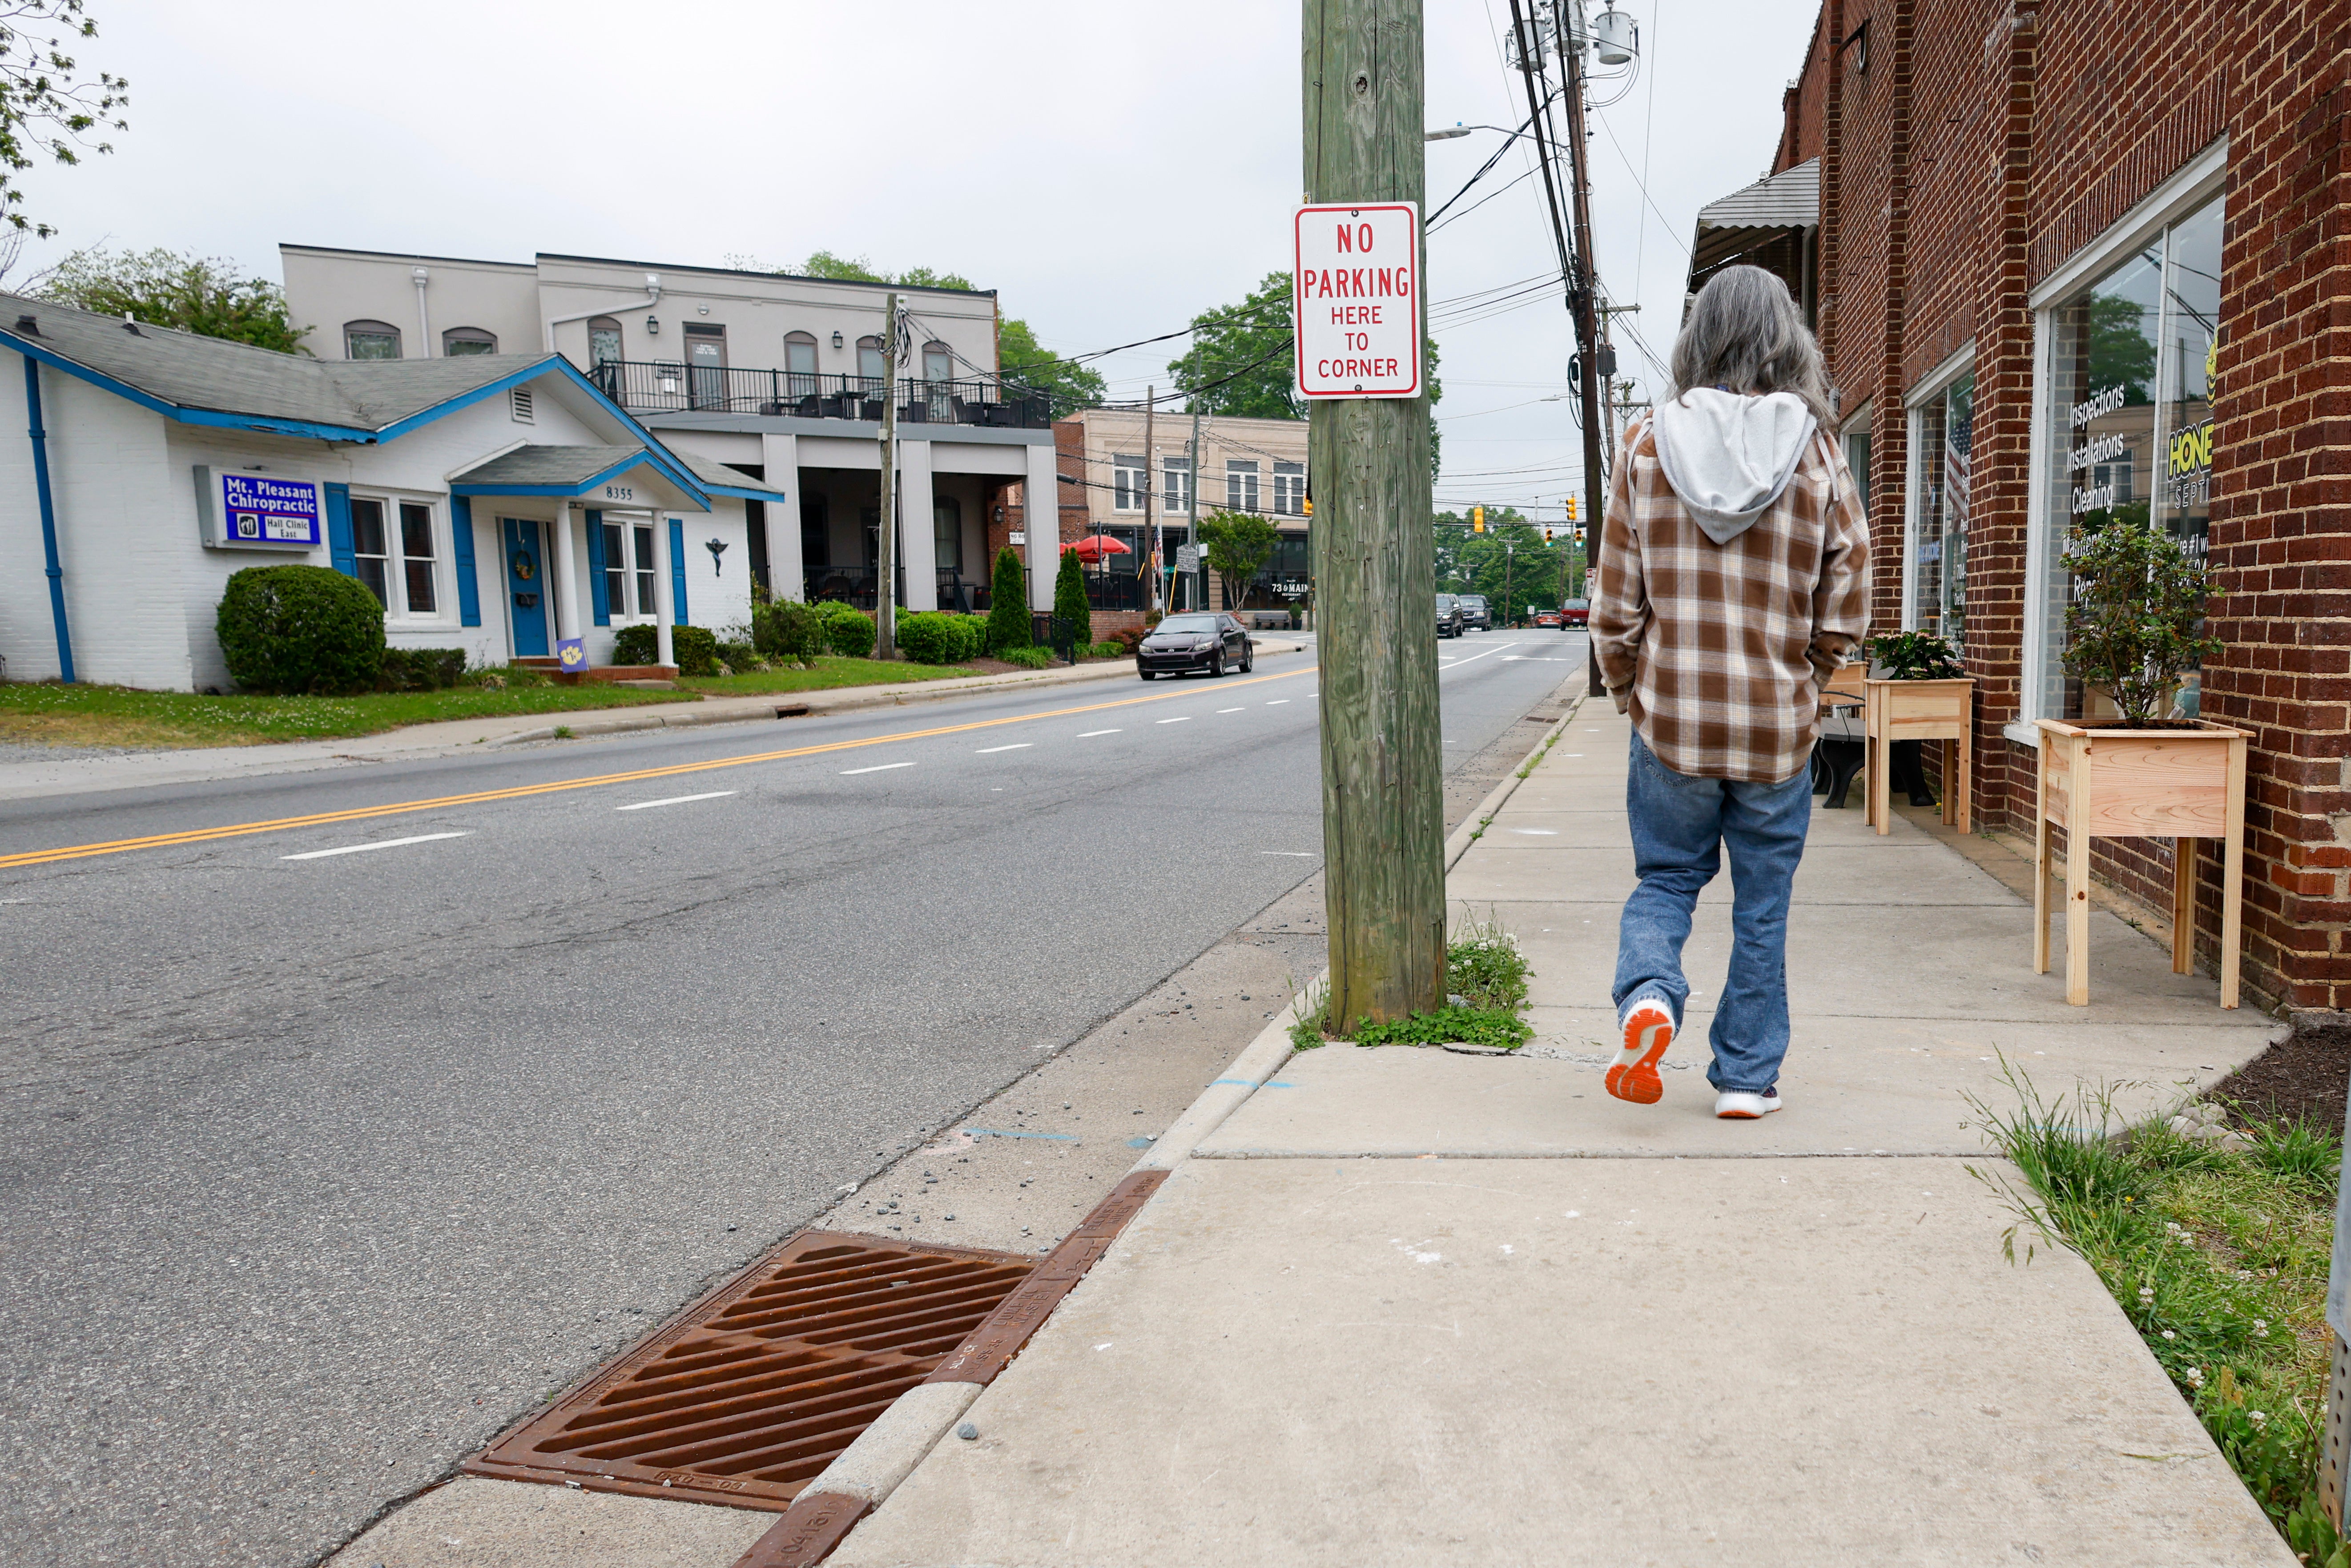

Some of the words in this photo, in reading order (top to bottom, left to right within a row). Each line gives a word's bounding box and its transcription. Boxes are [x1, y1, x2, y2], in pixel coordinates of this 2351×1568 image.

[1337, 223, 1373, 253] NO
[1304, 267, 1408, 298] PARKING
[1331, 306, 1383, 325] HERE
[1345, 332, 1369, 351] TO
[1318, 358, 1398, 378] CORNER
[2069, 384, 2124, 429] Inspections
[2067, 432, 2124, 473] Installations
[2169, 423, 2214, 476] HONE
[226, 478, 253, 494] Mt.
[257, 481, 314, 499] Pleasant
[607, 486, 632, 500] 8355
[2072, 481, 2113, 515] Cleaning
[2175, 478, 2210, 509] SEPTI
[227, 493, 315, 513] Chiropractic
[267, 519, 283, 527] Hall
[286, 520, 308, 529] Clinic
[280, 529, 297, 538] East
[1272, 583, 1282, 592] 73
[1289, 584, 1308, 592] MAIN
